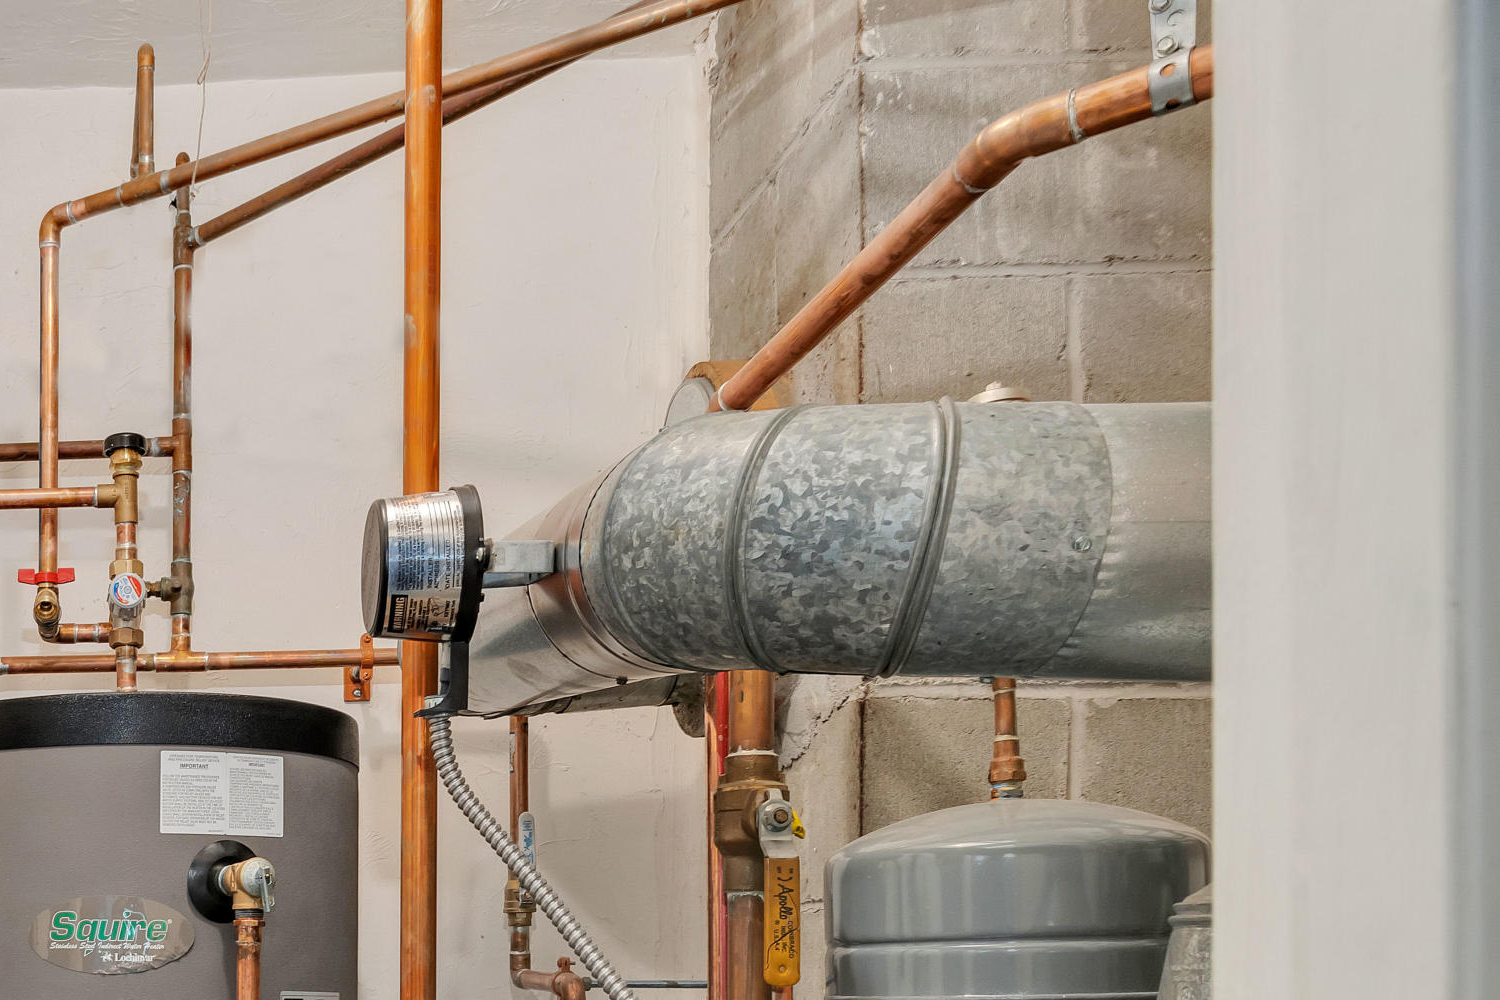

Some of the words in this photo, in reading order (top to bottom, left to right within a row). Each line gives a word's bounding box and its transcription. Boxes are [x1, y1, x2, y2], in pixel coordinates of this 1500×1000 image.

[773, 883, 794, 920] Apollo
[49, 909, 169, 945] Squire
[98, 942, 122, 950] Indirect
